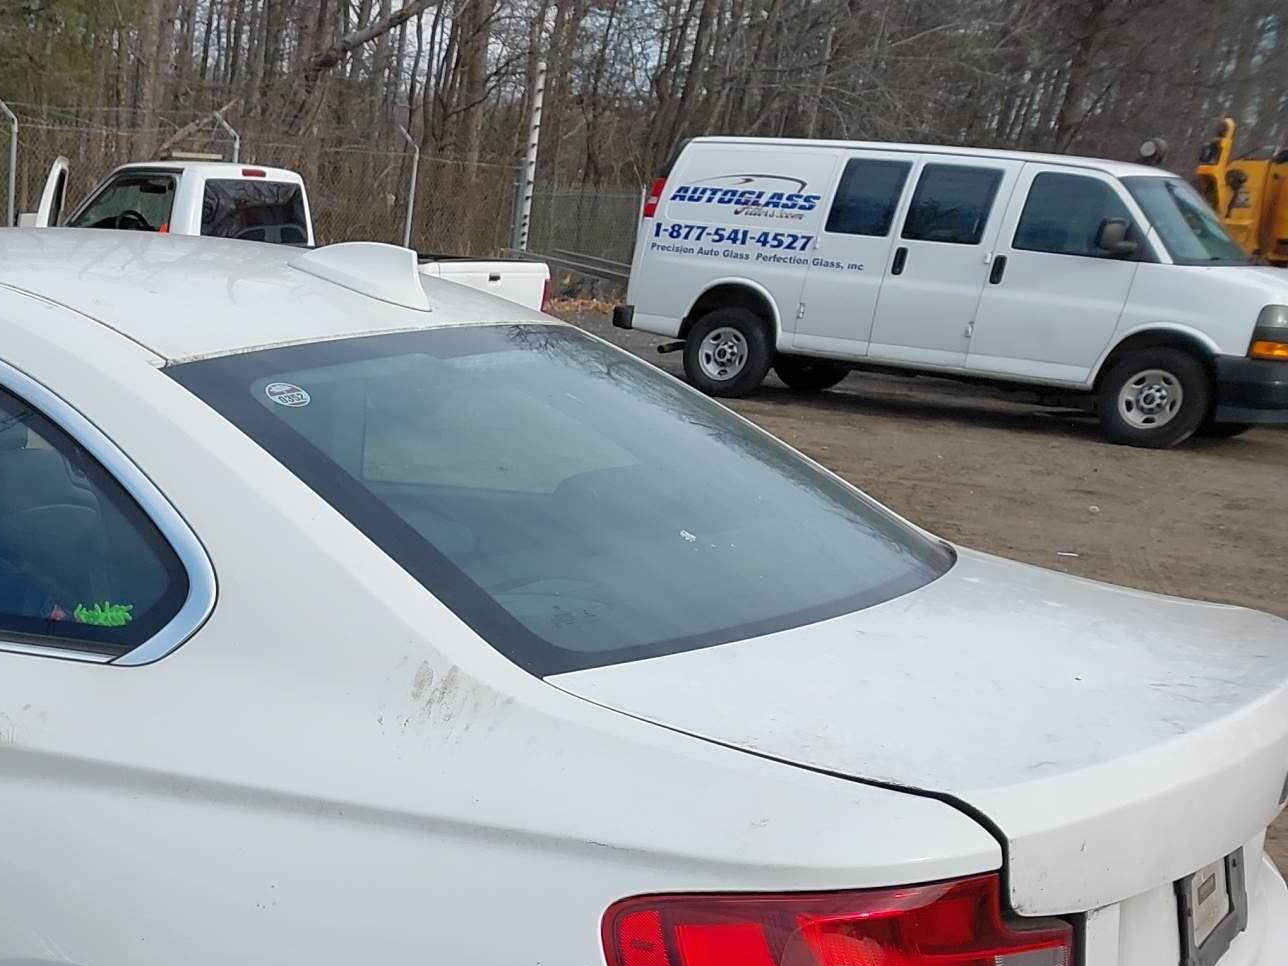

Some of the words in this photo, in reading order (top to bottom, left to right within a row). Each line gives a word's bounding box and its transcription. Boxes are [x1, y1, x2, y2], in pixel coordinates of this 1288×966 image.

[670, 186, 821, 211] AUTOGLASS
[654, 222, 814, 251] 1-877-541-4527
[650, 242, 694, 255] Precision
[697, 246, 719, 256] Auto
[722, 249, 750, 260] Glass
[756, 252, 809, 265] Perfection
[812, 257, 844, 270] Glass,
